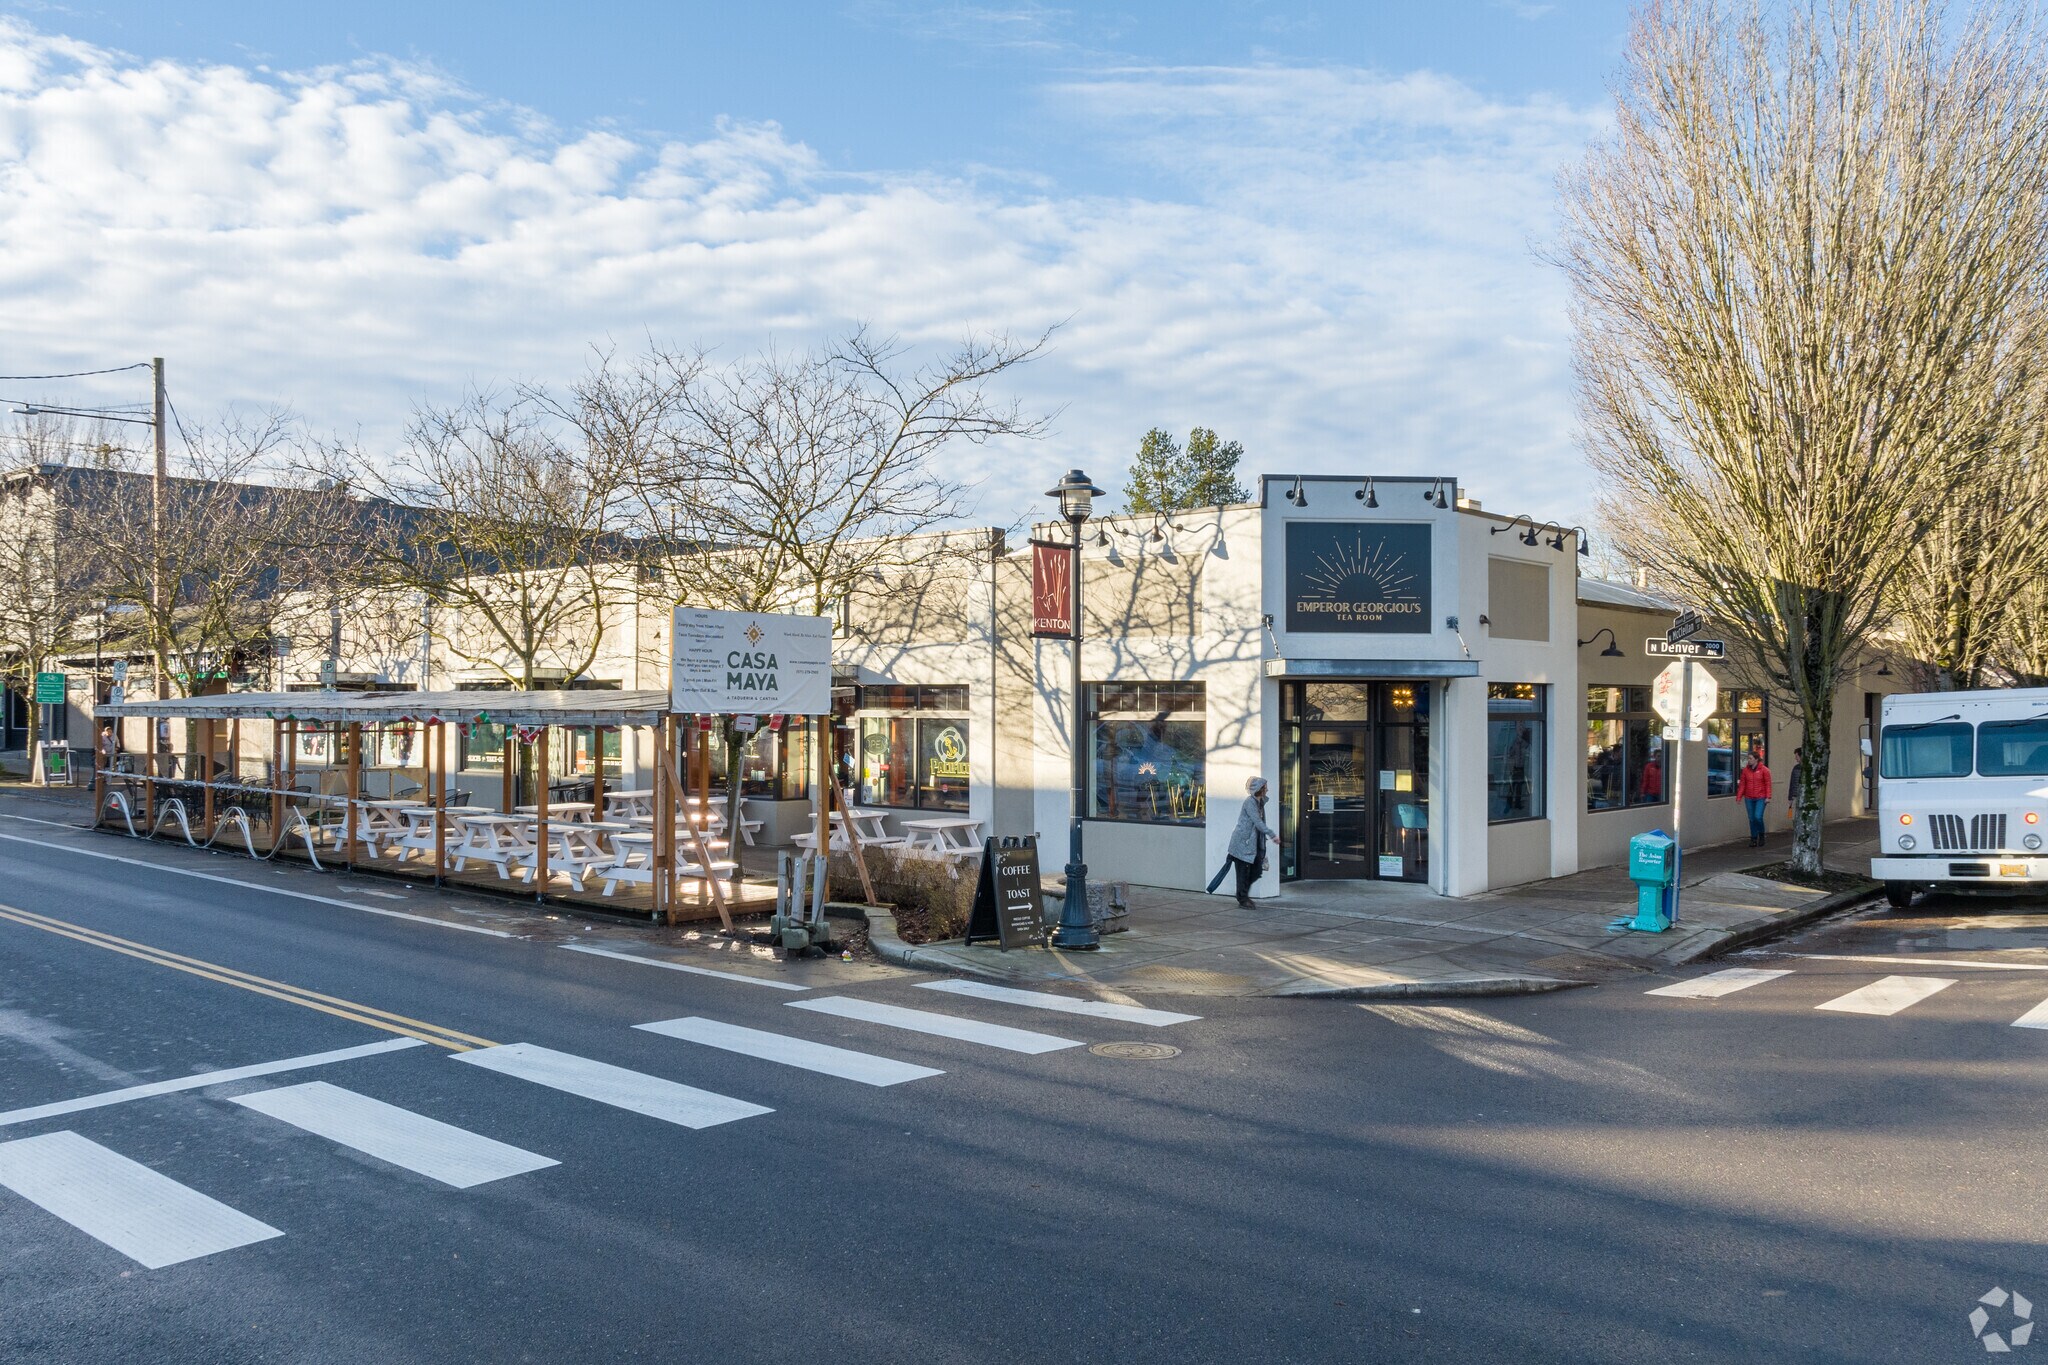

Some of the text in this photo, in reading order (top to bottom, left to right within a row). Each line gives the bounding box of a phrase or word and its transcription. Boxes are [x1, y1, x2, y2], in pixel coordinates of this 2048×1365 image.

[1296, 602, 1422, 614] EMPEROR GEORGIOU'S
[1337, 613, 1353, 621] TEA
[1034, 618, 1070, 629] KENTON
[1650, 642, 1700, 654] N Denver
[727, 651, 778, 670] CASA
[727, 672, 778, 691] MAYA
[1002, 865, 1031, 876] COFFEE
[1006, 888, 1030, 899] TOAST
